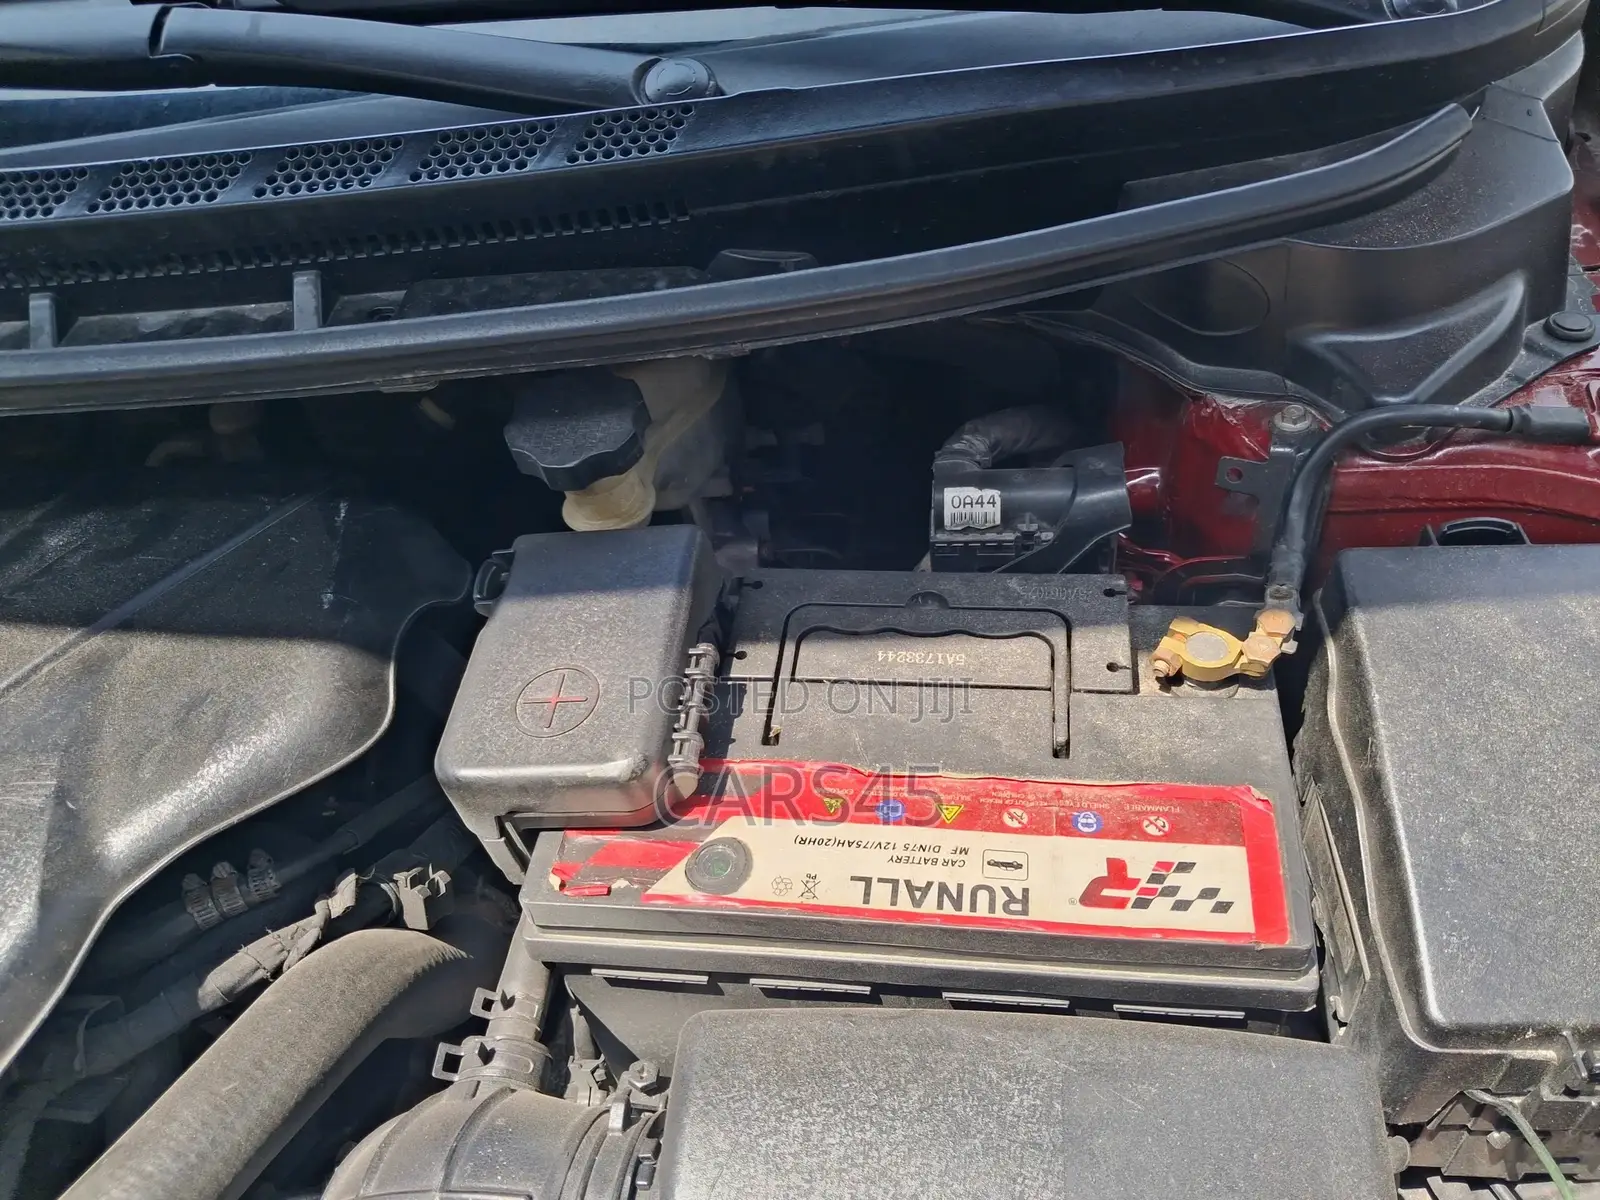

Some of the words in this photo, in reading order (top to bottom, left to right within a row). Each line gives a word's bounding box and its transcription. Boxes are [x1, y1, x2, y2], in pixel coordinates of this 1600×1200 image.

[1082, 800, 1110, 810] SHIELD
[1123, 803, 1180, 813] FLAMMABLE
[794, 834, 897, 851] 12V/75AH(20HR)
[903, 843, 942, 854] DIN75
[951, 846, 970, 856] MF
[887, 854, 939, 867] BATTERY
[941, 858, 966, 868] CAR
[805, 872, 818, 881] Pb
[849, 875, 1030, 917] RUNALL
